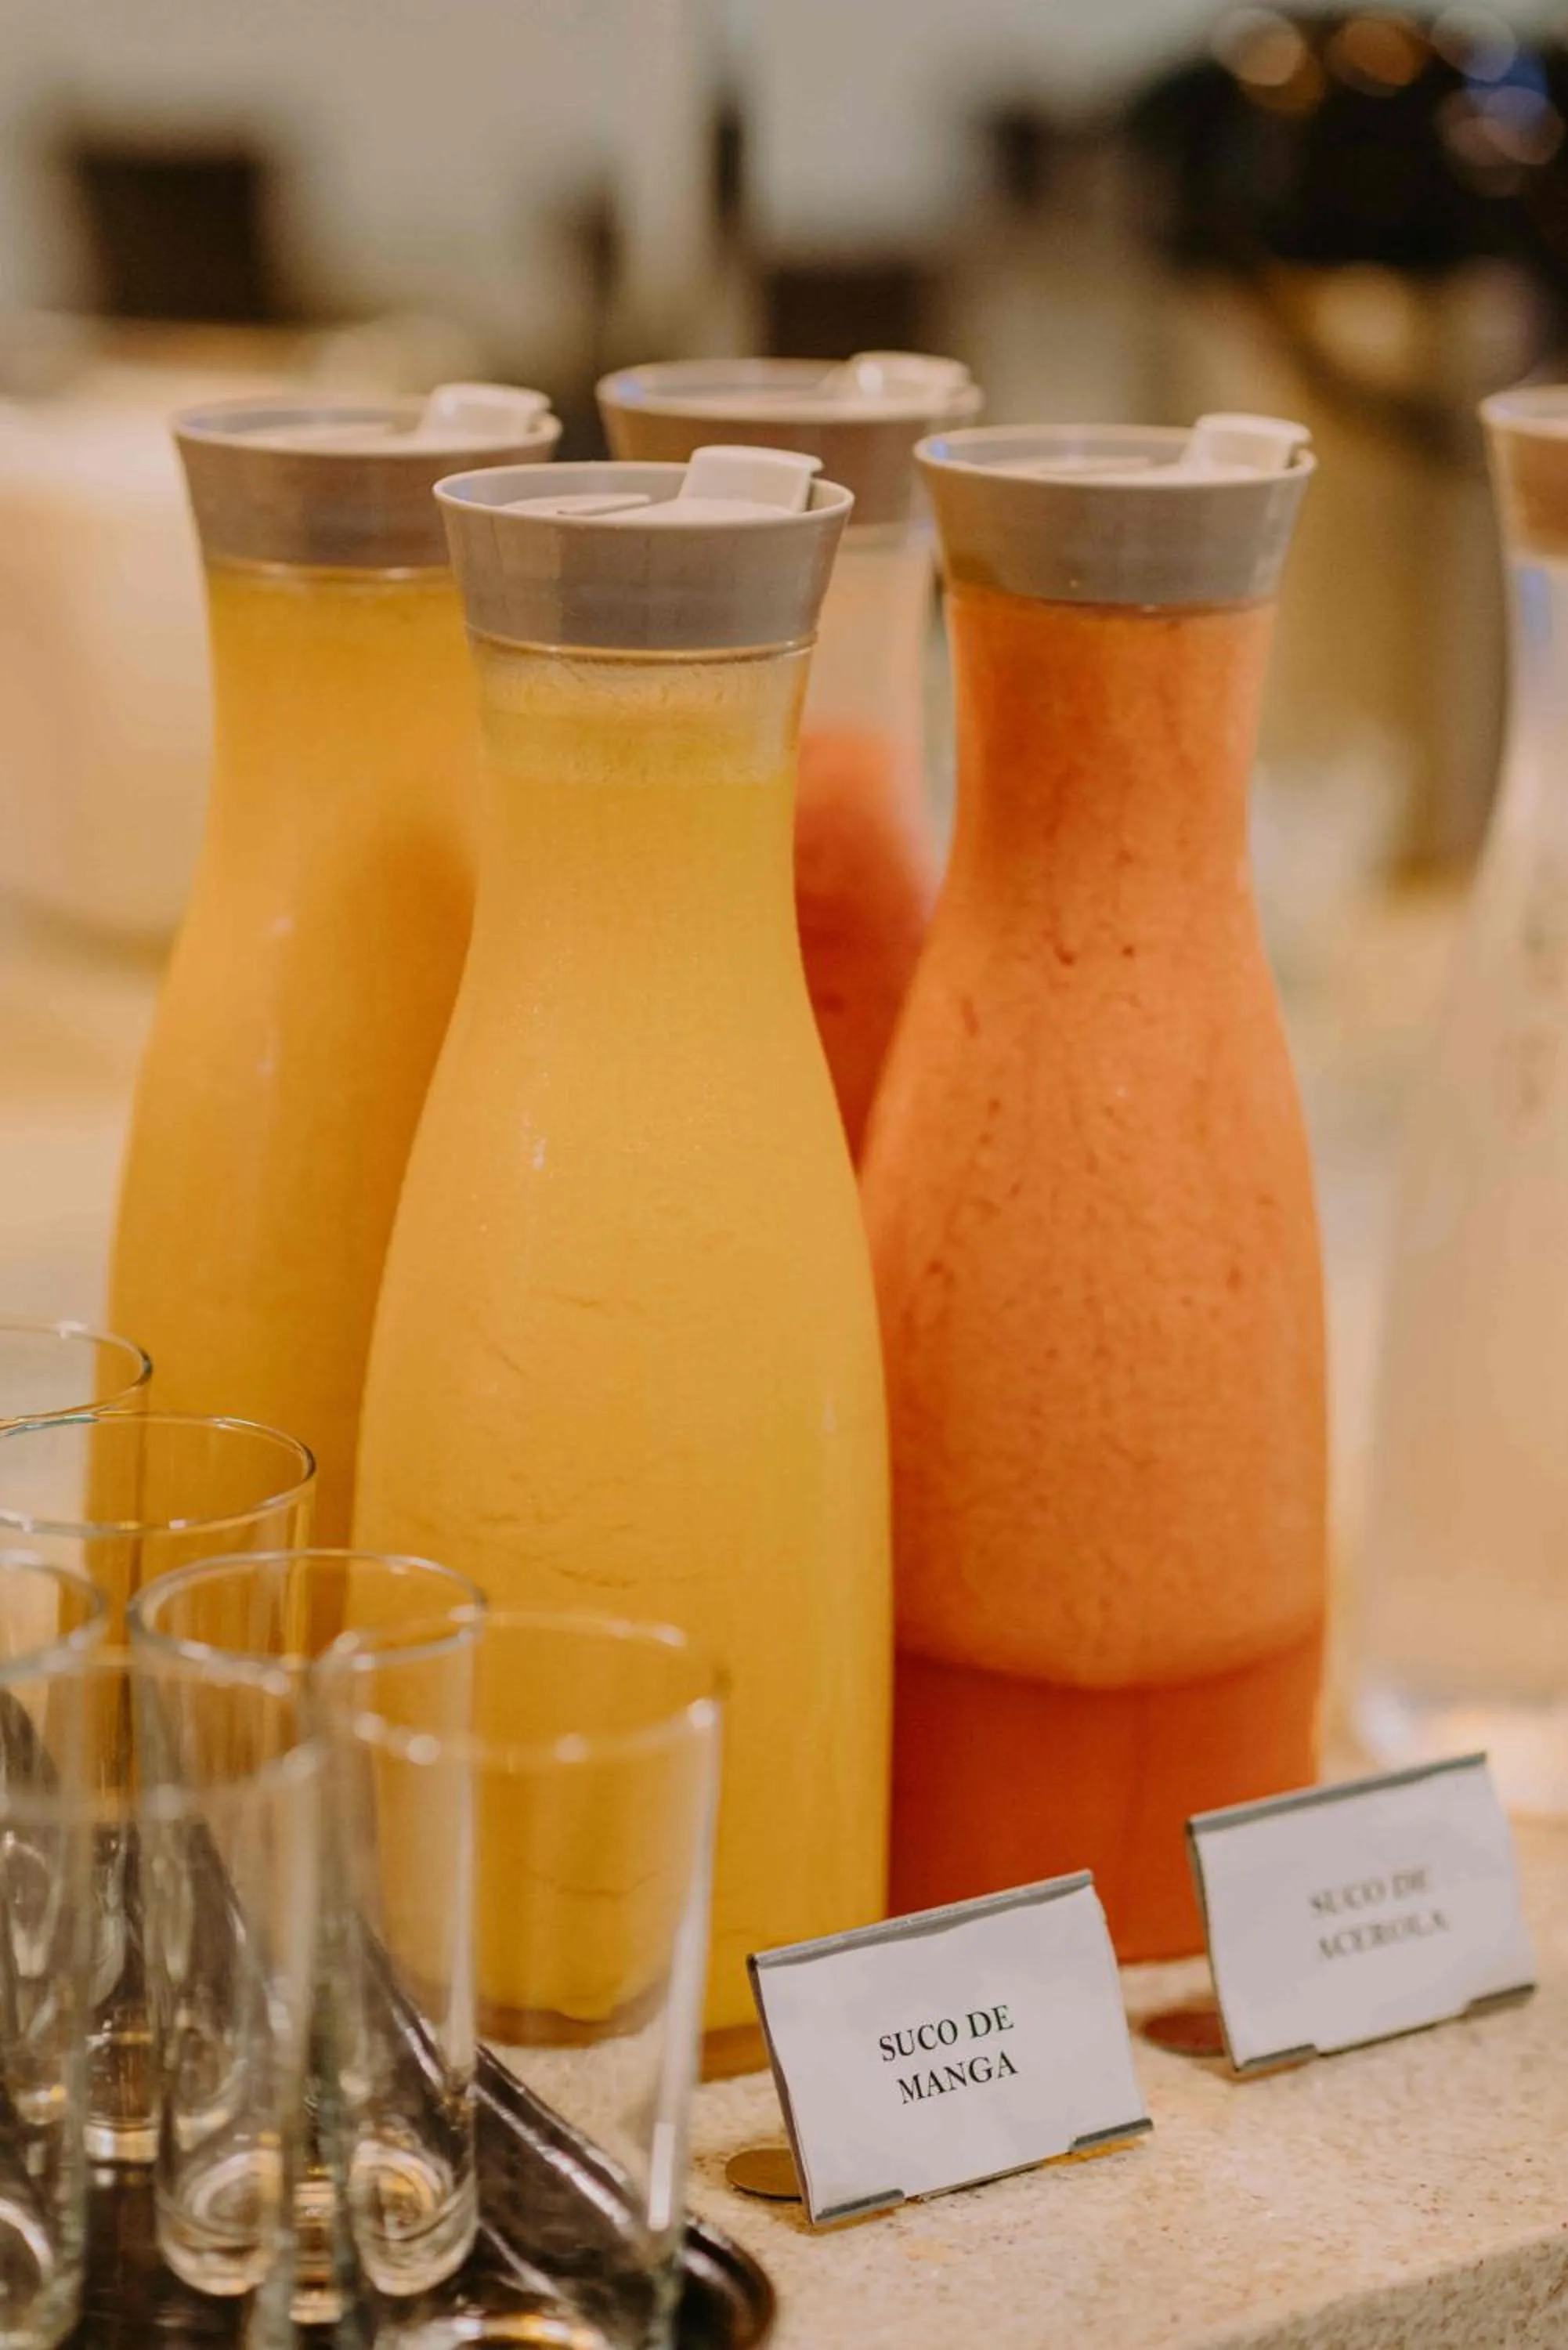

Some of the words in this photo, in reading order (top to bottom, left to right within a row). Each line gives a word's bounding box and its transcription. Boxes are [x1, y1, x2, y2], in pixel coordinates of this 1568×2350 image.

[1310, 1881, 1387, 1917] SUCO
[1391, 1868, 1429, 1901] DE
[879, 2019, 959, 2063] SUCO
[965, 2005, 1014, 2039] DE
[896, 2050, 1019, 2105] MANGA
